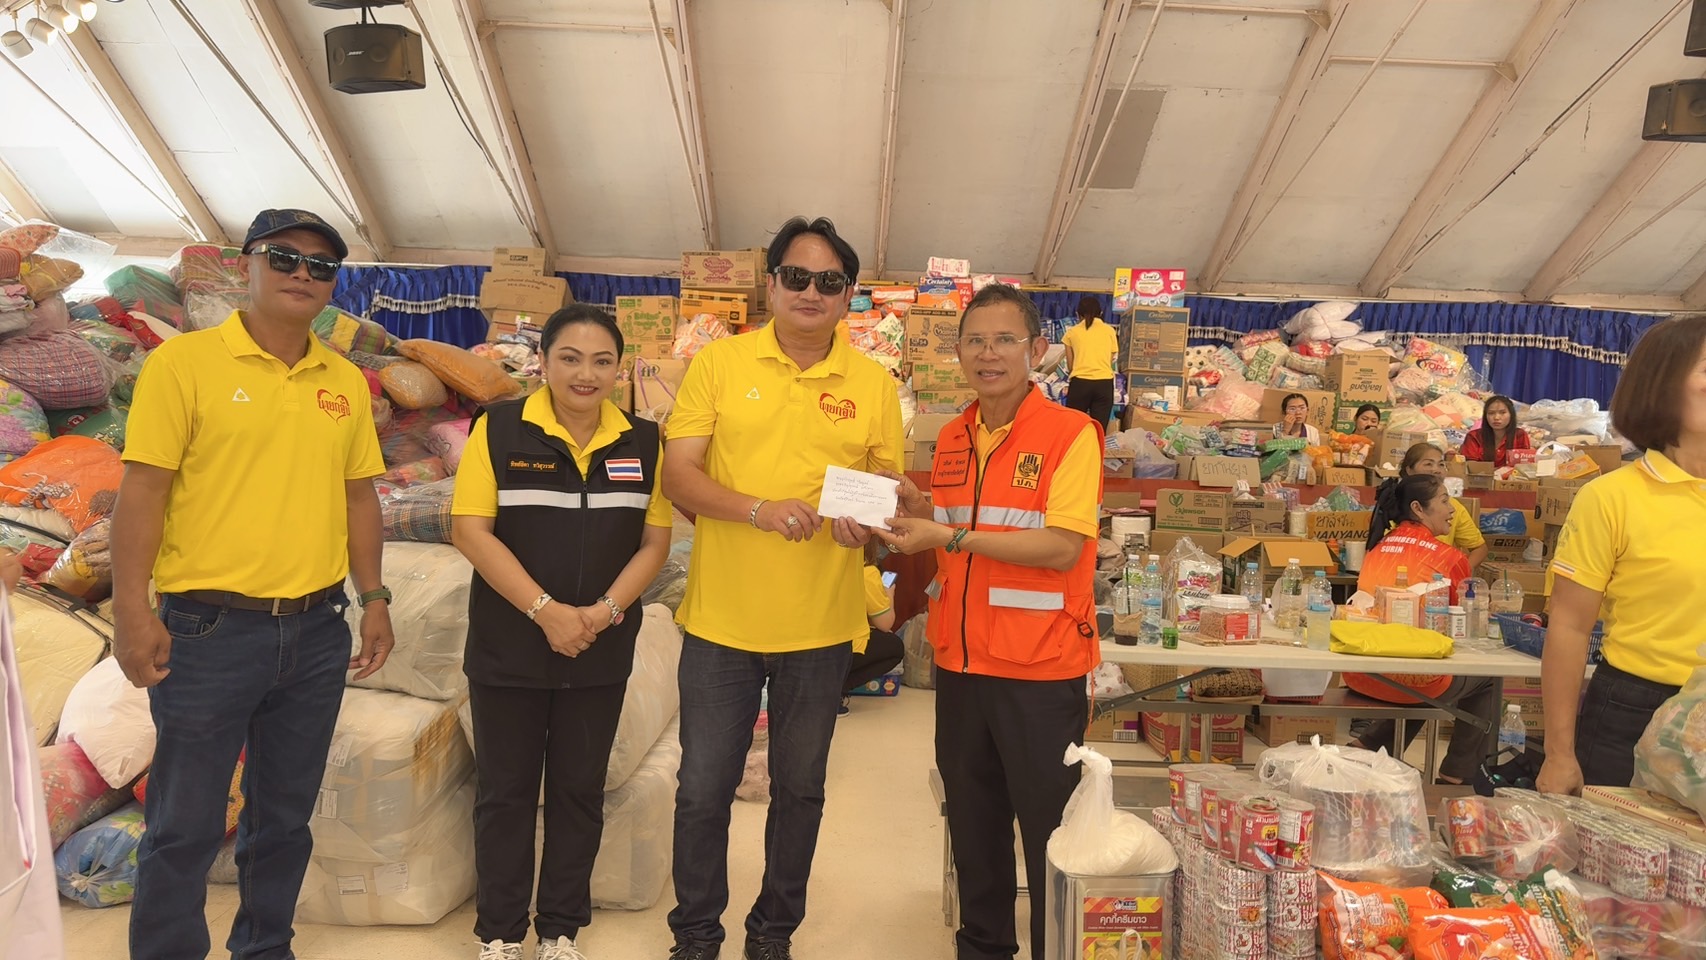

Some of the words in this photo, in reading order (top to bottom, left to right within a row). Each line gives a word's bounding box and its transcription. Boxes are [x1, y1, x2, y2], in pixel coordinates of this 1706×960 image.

[1380, 545, 1405, 554] SURIN
[1384, 535, 1418, 545] NUMBER
[1418, 540, 1439, 552] ONE
[1099, 912, 1148, 926] คุกกี้ครีมขาว
